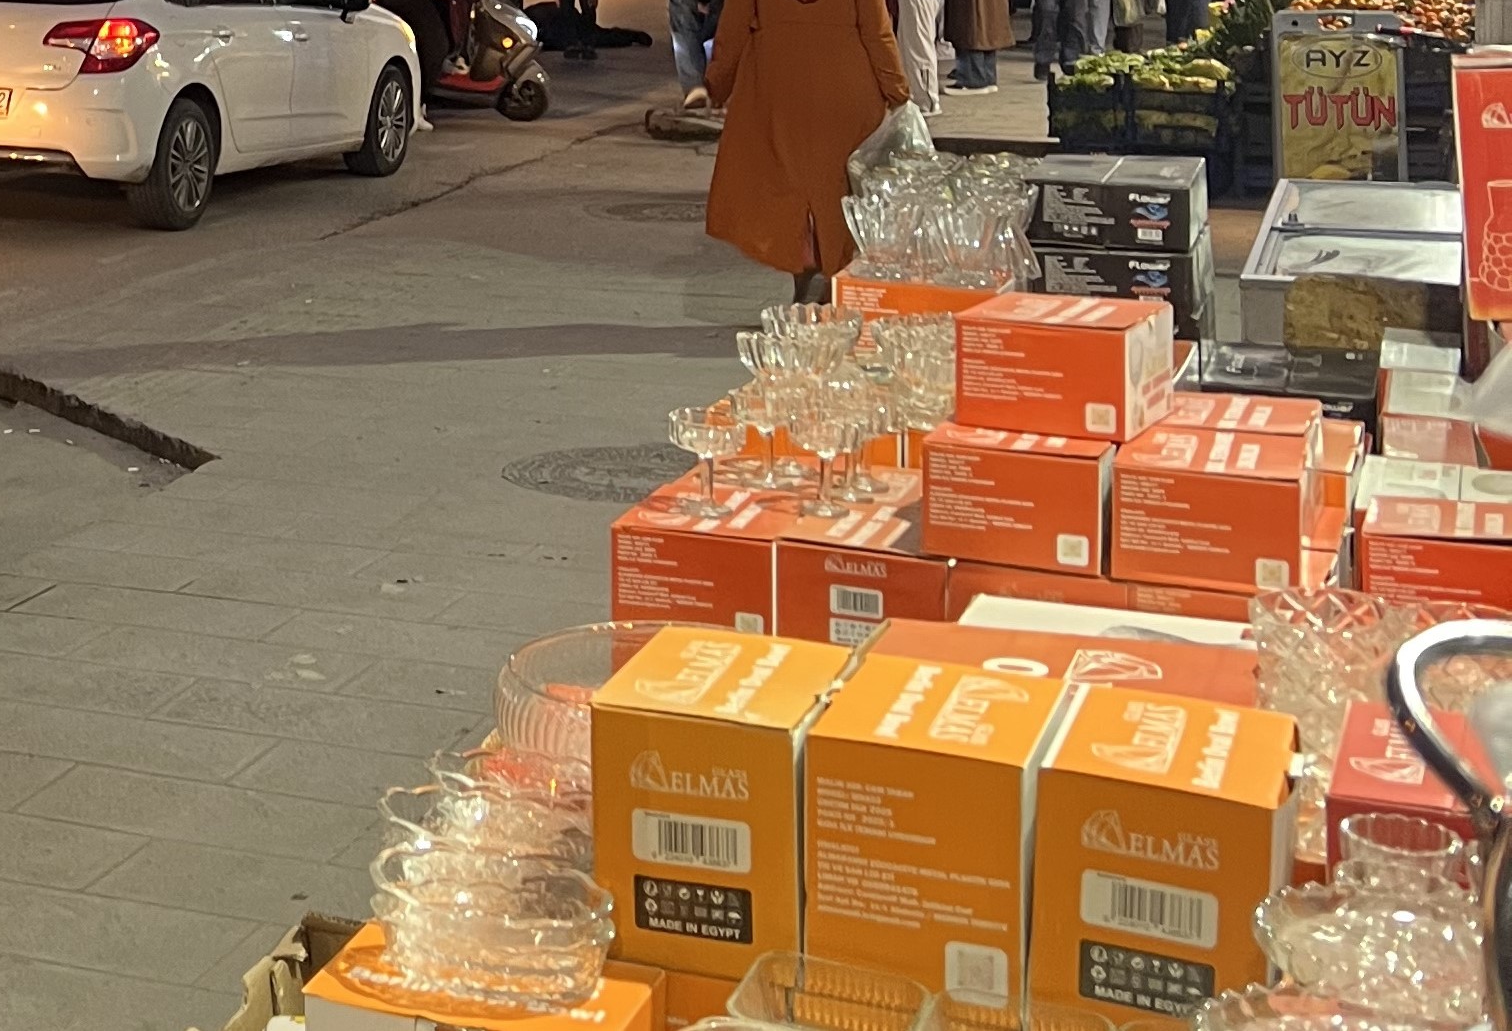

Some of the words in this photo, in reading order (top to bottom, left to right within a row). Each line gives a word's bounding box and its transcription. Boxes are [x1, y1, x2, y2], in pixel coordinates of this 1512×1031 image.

[1305, 49, 1371, 69] AYZ
[1283, 86, 1397, 131] TÜTÜN
[671, 771, 750, 801] ELMAS
[1129, 832, 1219, 870] ELMAS
[649, 916, 683, 933] MADE
[686, 921, 698, 934] IN
[701, 924, 741, 940] EGYPT
[1094, 984, 1134, 1003] MADE
[1136, 993, 1152, 1007] IN
